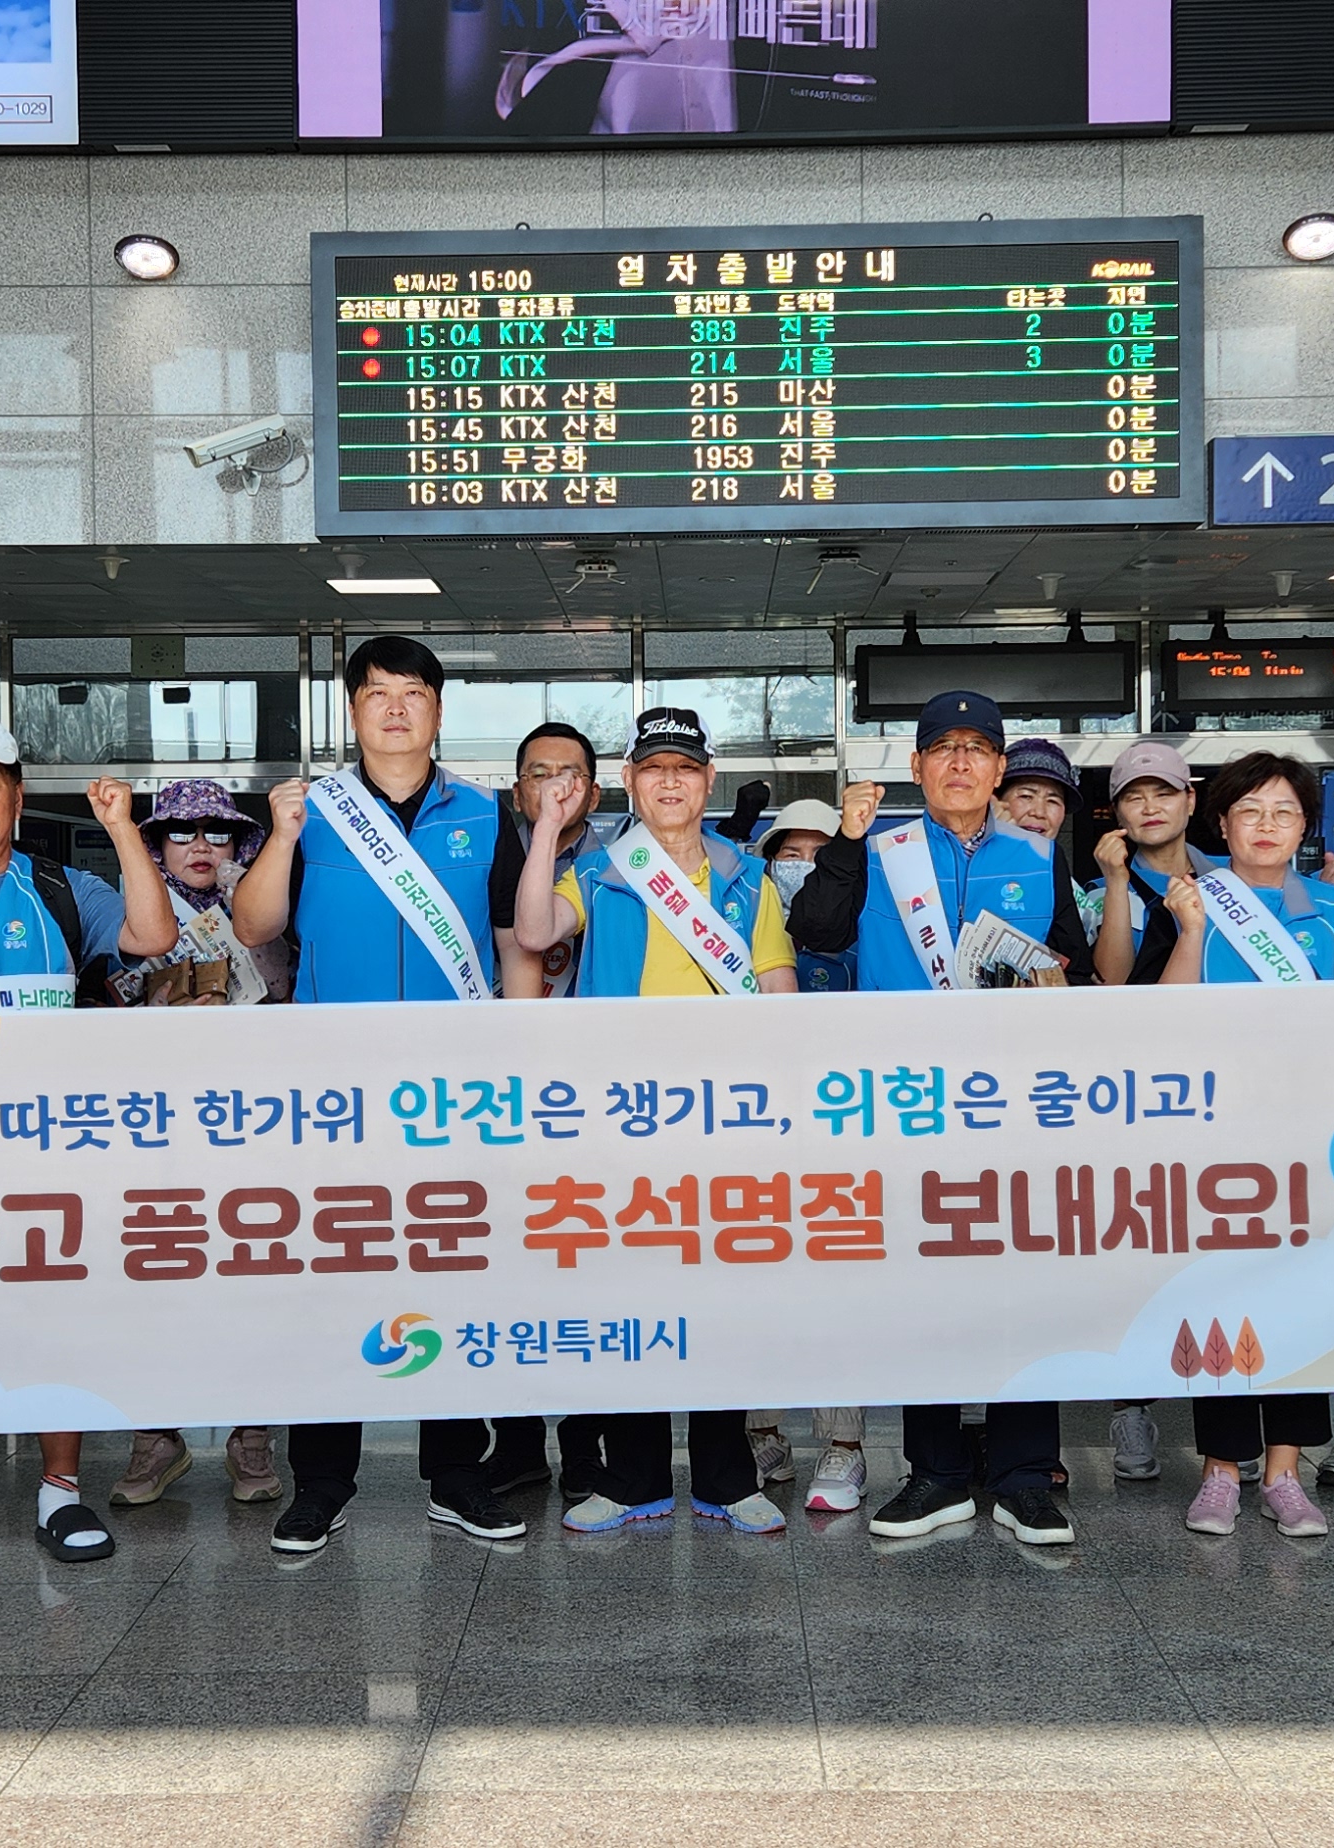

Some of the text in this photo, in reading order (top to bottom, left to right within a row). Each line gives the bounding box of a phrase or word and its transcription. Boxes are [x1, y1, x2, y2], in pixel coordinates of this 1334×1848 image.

[393, 270, 532, 293] 현재시간 15:00
[1091, 260, 1155, 279] KORAIL
[673, 294, 752, 316] 열차번호
[405, 311, 1157, 346] 15:04 KTX 산천 383 진주 2 0분
[406, 342, 1157, 378] 15:07 KTX 214 서울 3 0분
[407, 374, 1157, 411] 15:15 KTX 산천 215 마산 0분
[407, 406, 1157, 442] 15:45 KTX 산천 216 서울 0분
[408, 437, 1157, 474] 15:51 무궁화 1953 진주 0분
[408, 469, 1157, 505] 16:03 KTX 산천 218 서울 0분
[193, 1086, 366, 1146] 한가위
[388, 1074, 586, 1148] 안전은
[605, 1078, 793, 1138] 챙기고,
[812, 1066, 1008, 1138] 위험은
[1027, 1070, 1216, 1127] 줄이고!
[122, 1180, 492, 1282] 풍요로운
[522, 1169, 887, 1270] 추석명절
[918, 1161, 1310, 1257] 보내세요!
[455, 1316, 688, 1368] 창원특례시
